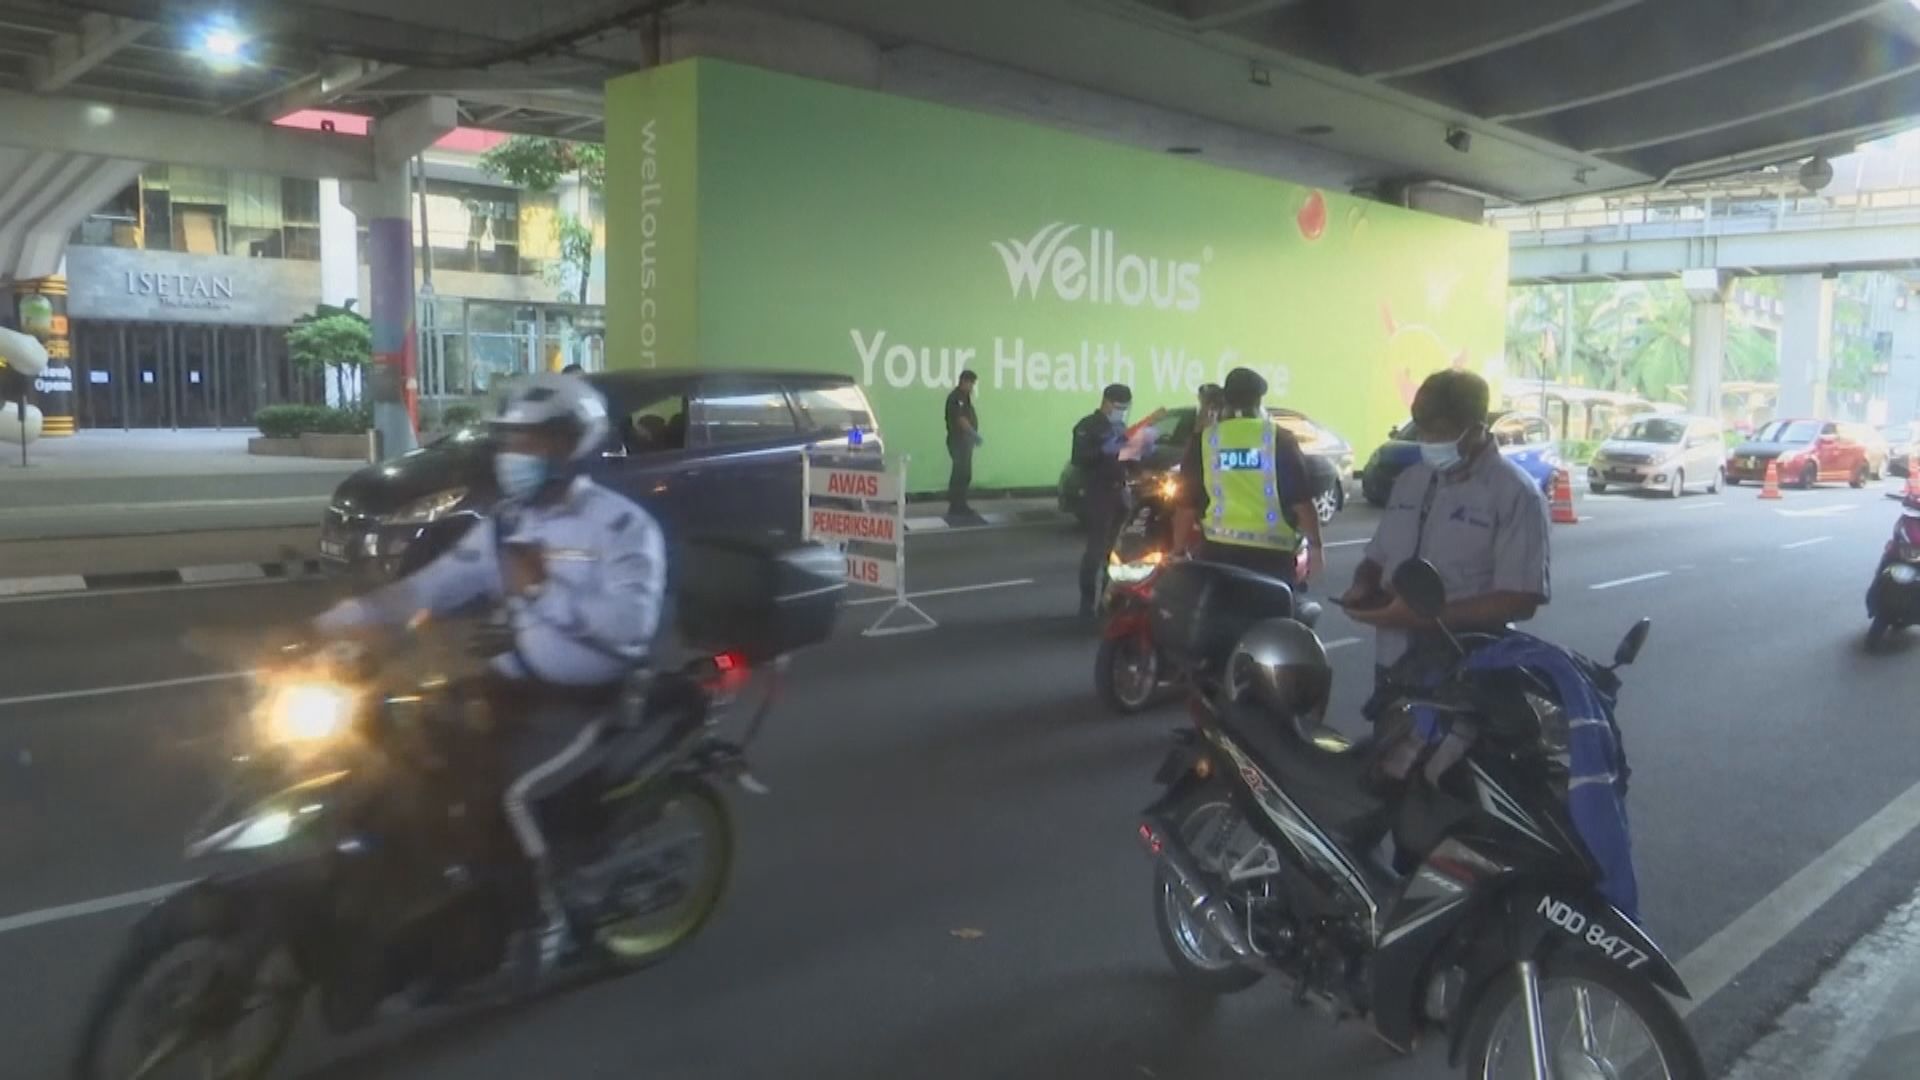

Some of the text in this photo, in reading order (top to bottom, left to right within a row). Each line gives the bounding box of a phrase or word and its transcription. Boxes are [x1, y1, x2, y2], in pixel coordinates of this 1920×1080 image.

[991, 221, 1202, 311] Wellous
[124, 271, 233, 299] ISETAN
[850, 328, 1290, 396] Your Health We Cre
[1219, 449, 1260, 469] POLIS
[827, 472, 879, 497] AWAS
[812, 511, 894, 540] PEMERIKSAAN
[847, 558, 879, 583] LIS
[1536, 895, 1649, 969] NDD 8477
